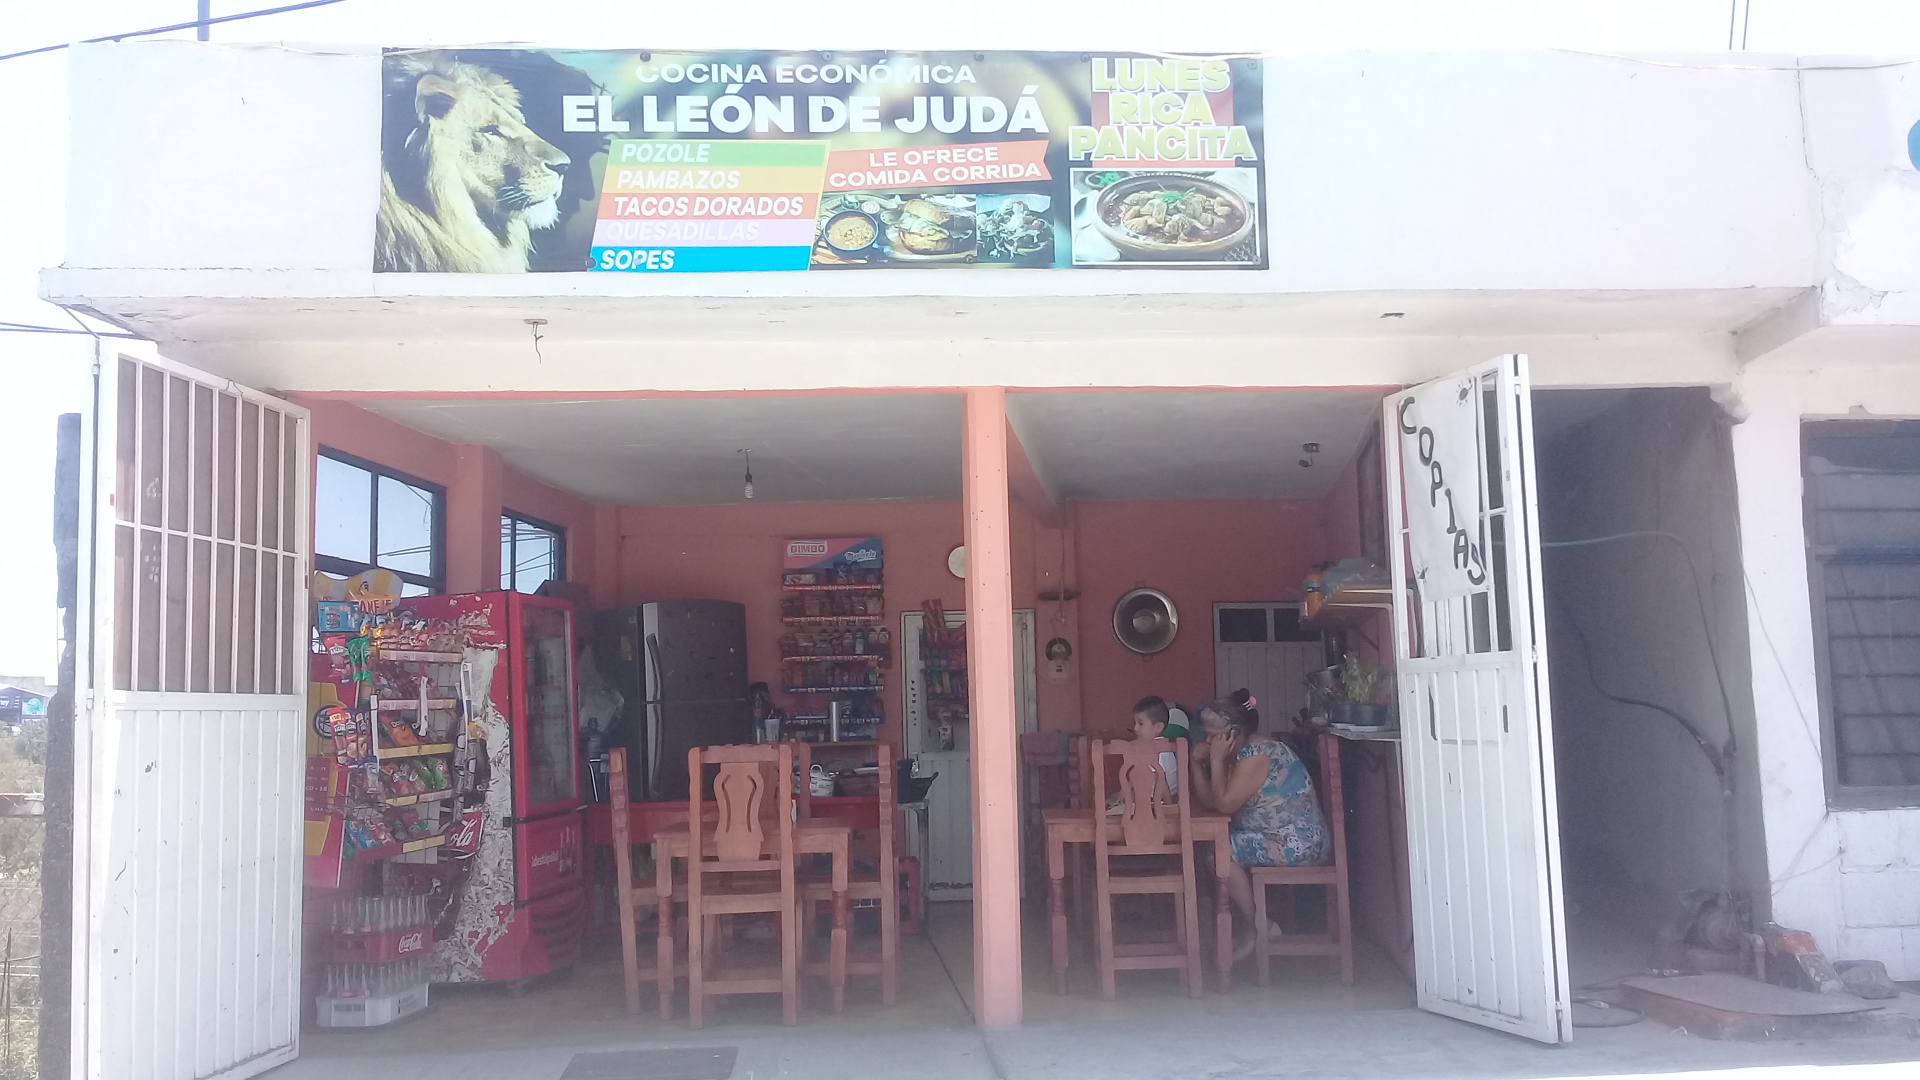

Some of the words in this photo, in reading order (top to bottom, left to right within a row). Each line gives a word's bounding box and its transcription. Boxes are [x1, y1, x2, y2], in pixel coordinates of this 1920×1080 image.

[636, 63, 767, 84] COCINA
[776, 59, 976, 85] ECONÓMICA
[1092, 57, 1231, 93] LUNES
[562, 94, 630, 134] EL
[642, 83, 805, 134] LEÓN
[808, 95, 881, 134] DE
[893, 85, 1050, 134] JUDÁ
[1109, 92, 1216, 126] RICA
[621, 143, 711, 164] POZOLE
[1068, 125, 1258, 161] PANCITA
[869, 148, 899, 168] LE
[903, 146, 999, 167] OFRECE
[616, 169, 741, 190] PAMBAZOS
[828, 167, 928, 188] COMIDA
[932, 163, 1042, 183] CORRIDA
[614, 196, 689, 217] TACOS
[693, 195, 804, 217] DORADOS
[606, 221, 760, 243] QUESADILLAS
[600, 249, 676, 270] SOPES
[1399, 396, 1487, 586] COPIAS
[790, 544, 826, 553] BIMBO
